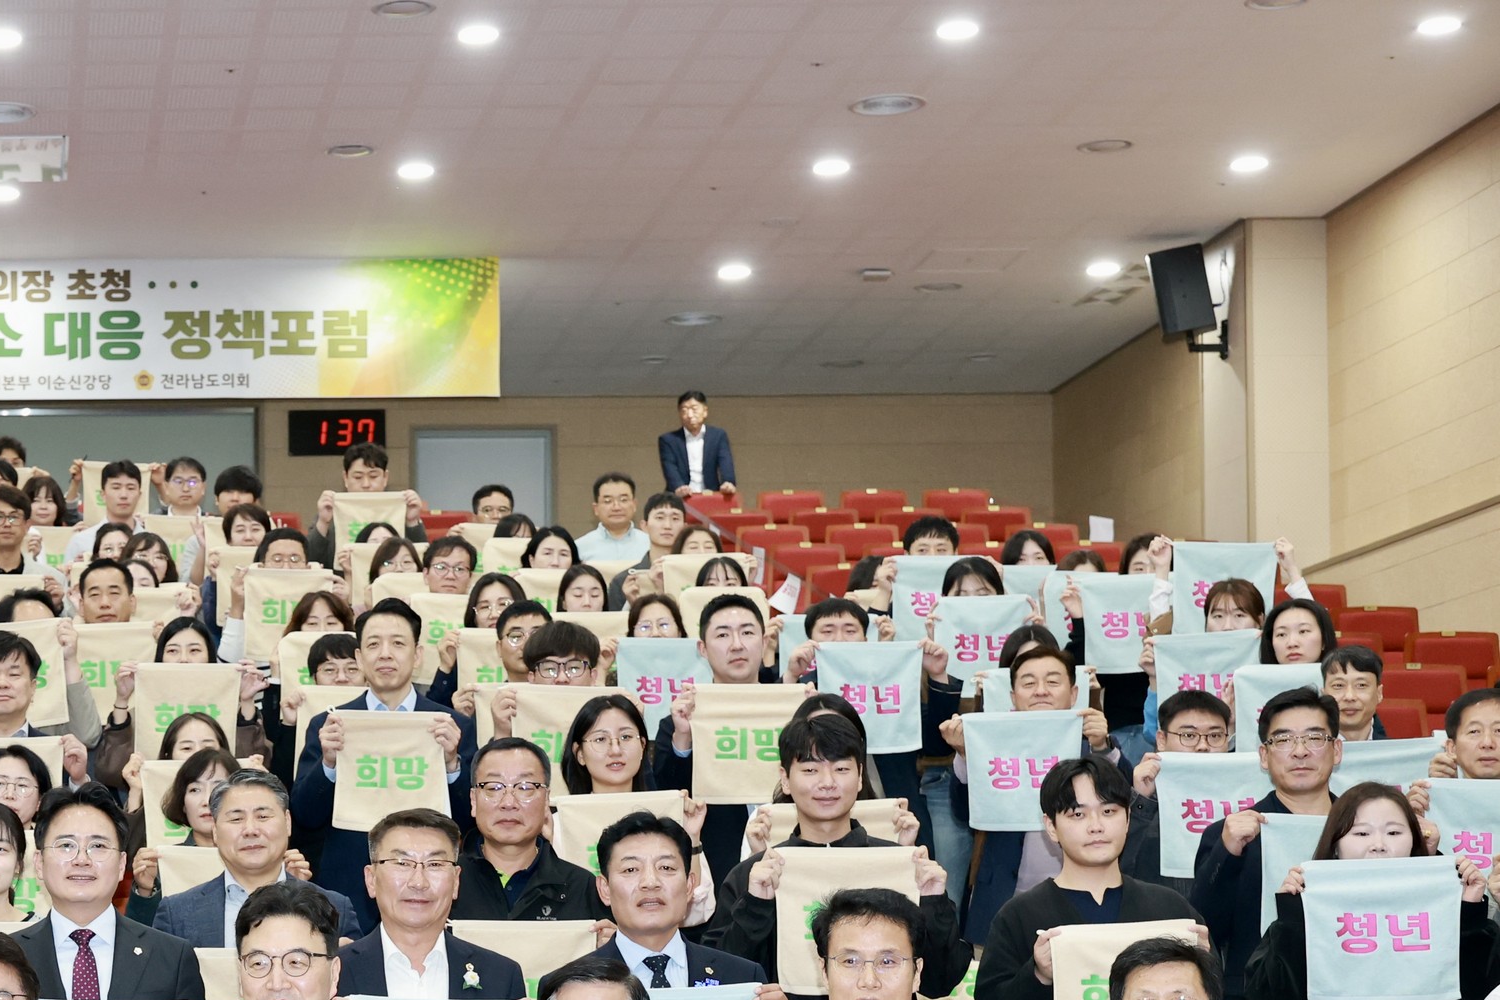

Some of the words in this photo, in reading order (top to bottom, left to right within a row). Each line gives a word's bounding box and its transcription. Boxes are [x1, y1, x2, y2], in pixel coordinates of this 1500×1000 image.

[66, 269, 132, 303] 초청
[43, 309, 145, 361] 대응
[162, 308, 369, 361] 정책포럼
[37, 374, 112, 391] 이순신강당
[160, 373, 250, 390] 전라남도의회
[261, 598, 300, 626] 희
[911, 591, 937, 618] 청
[354, 753, 431, 793] 희망
[1336, 911, 1432, 956] 청년
